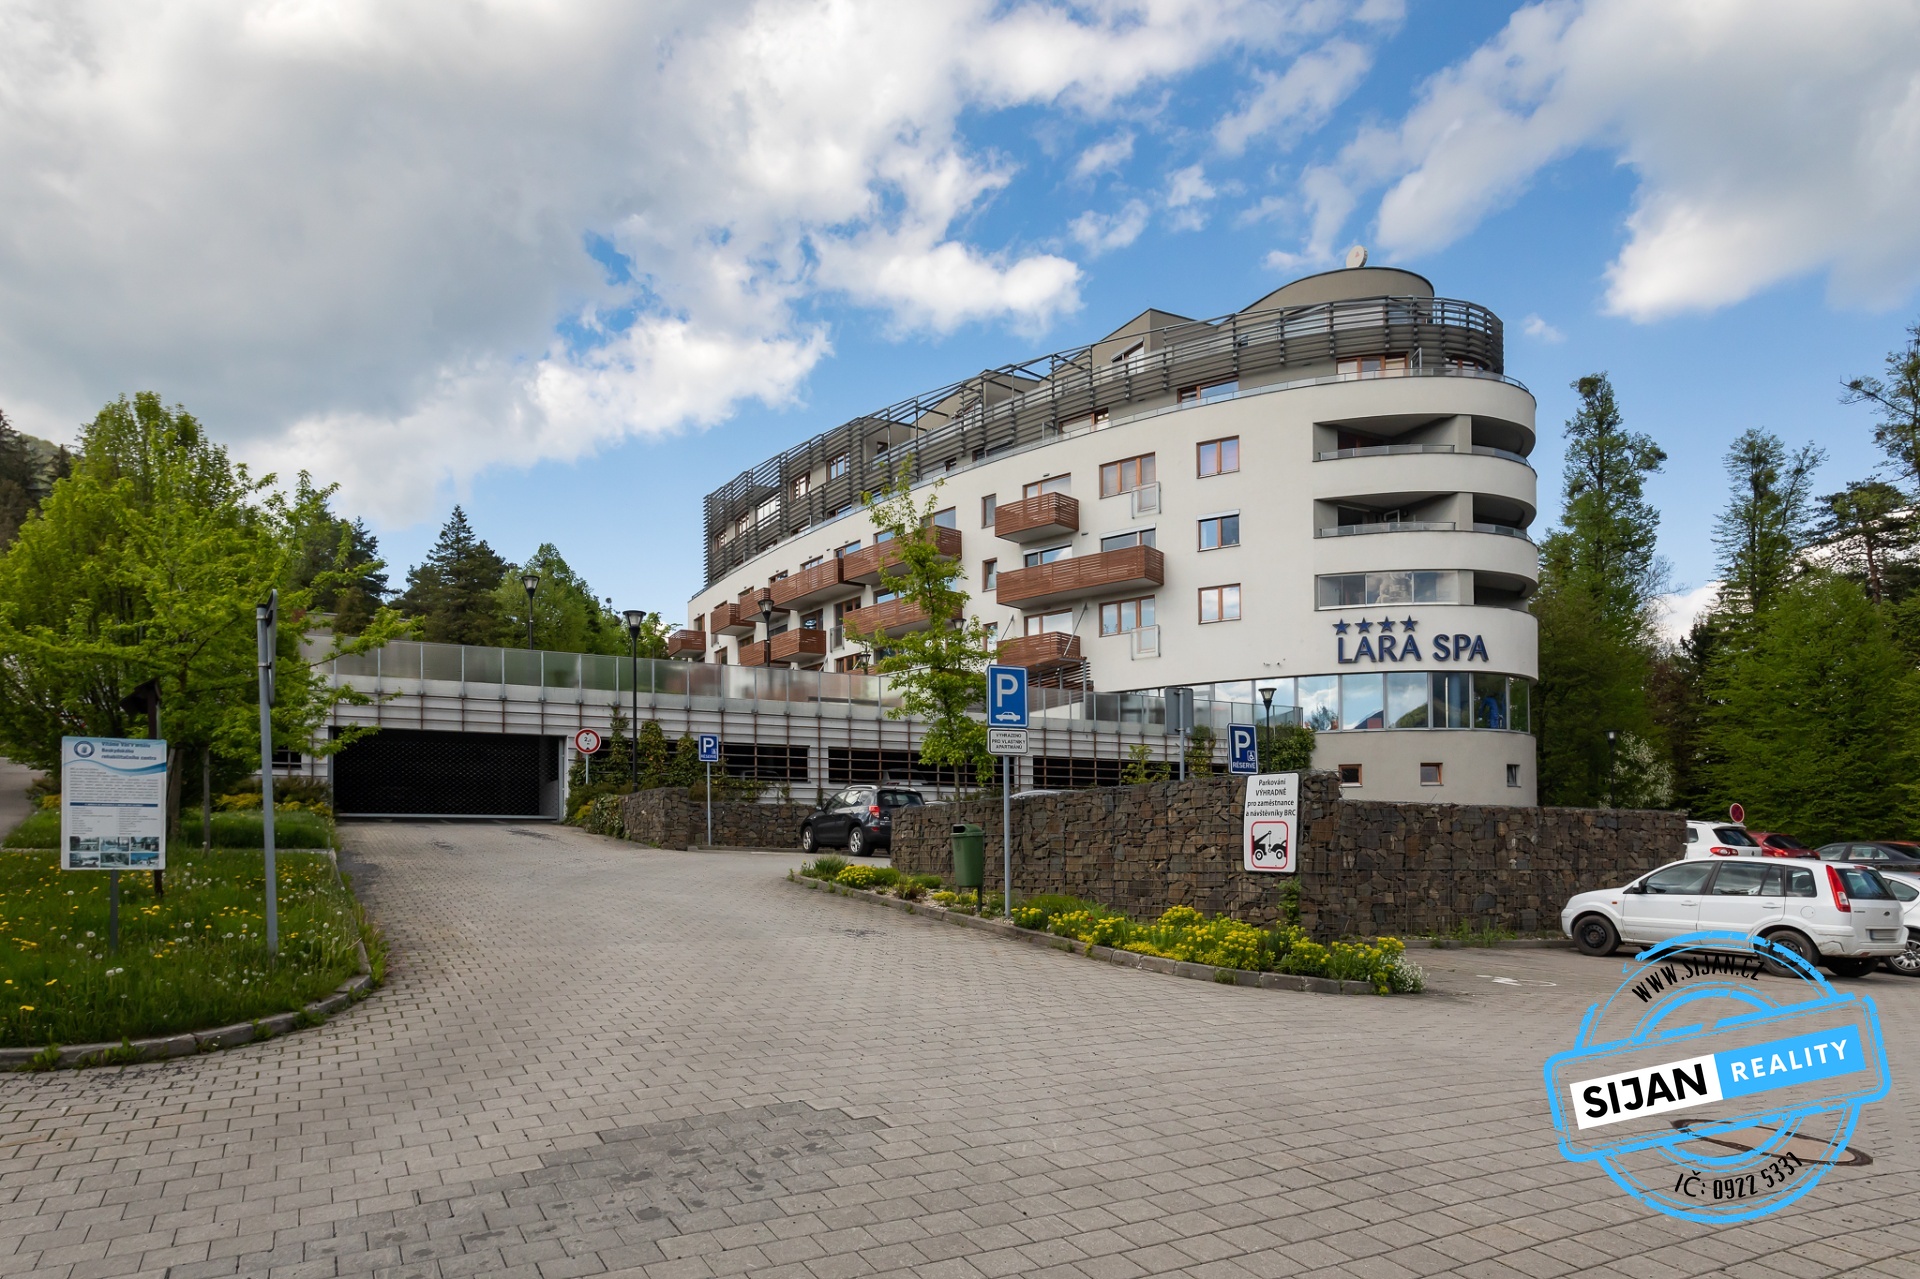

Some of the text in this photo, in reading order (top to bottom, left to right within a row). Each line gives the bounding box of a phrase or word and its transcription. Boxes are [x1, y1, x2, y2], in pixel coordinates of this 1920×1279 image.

[1337, 634, 1489, 664] LARA SPA
[996, 673, 1019, 707] P
[703, 737, 715, 753] P
[1234, 730, 1251, 759] P
[1258, 778, 1286, 786] Parkování
[1257, 799, 1295, 807] zaměstnance
[1250, 809, 1283, 817] návštěvníky
